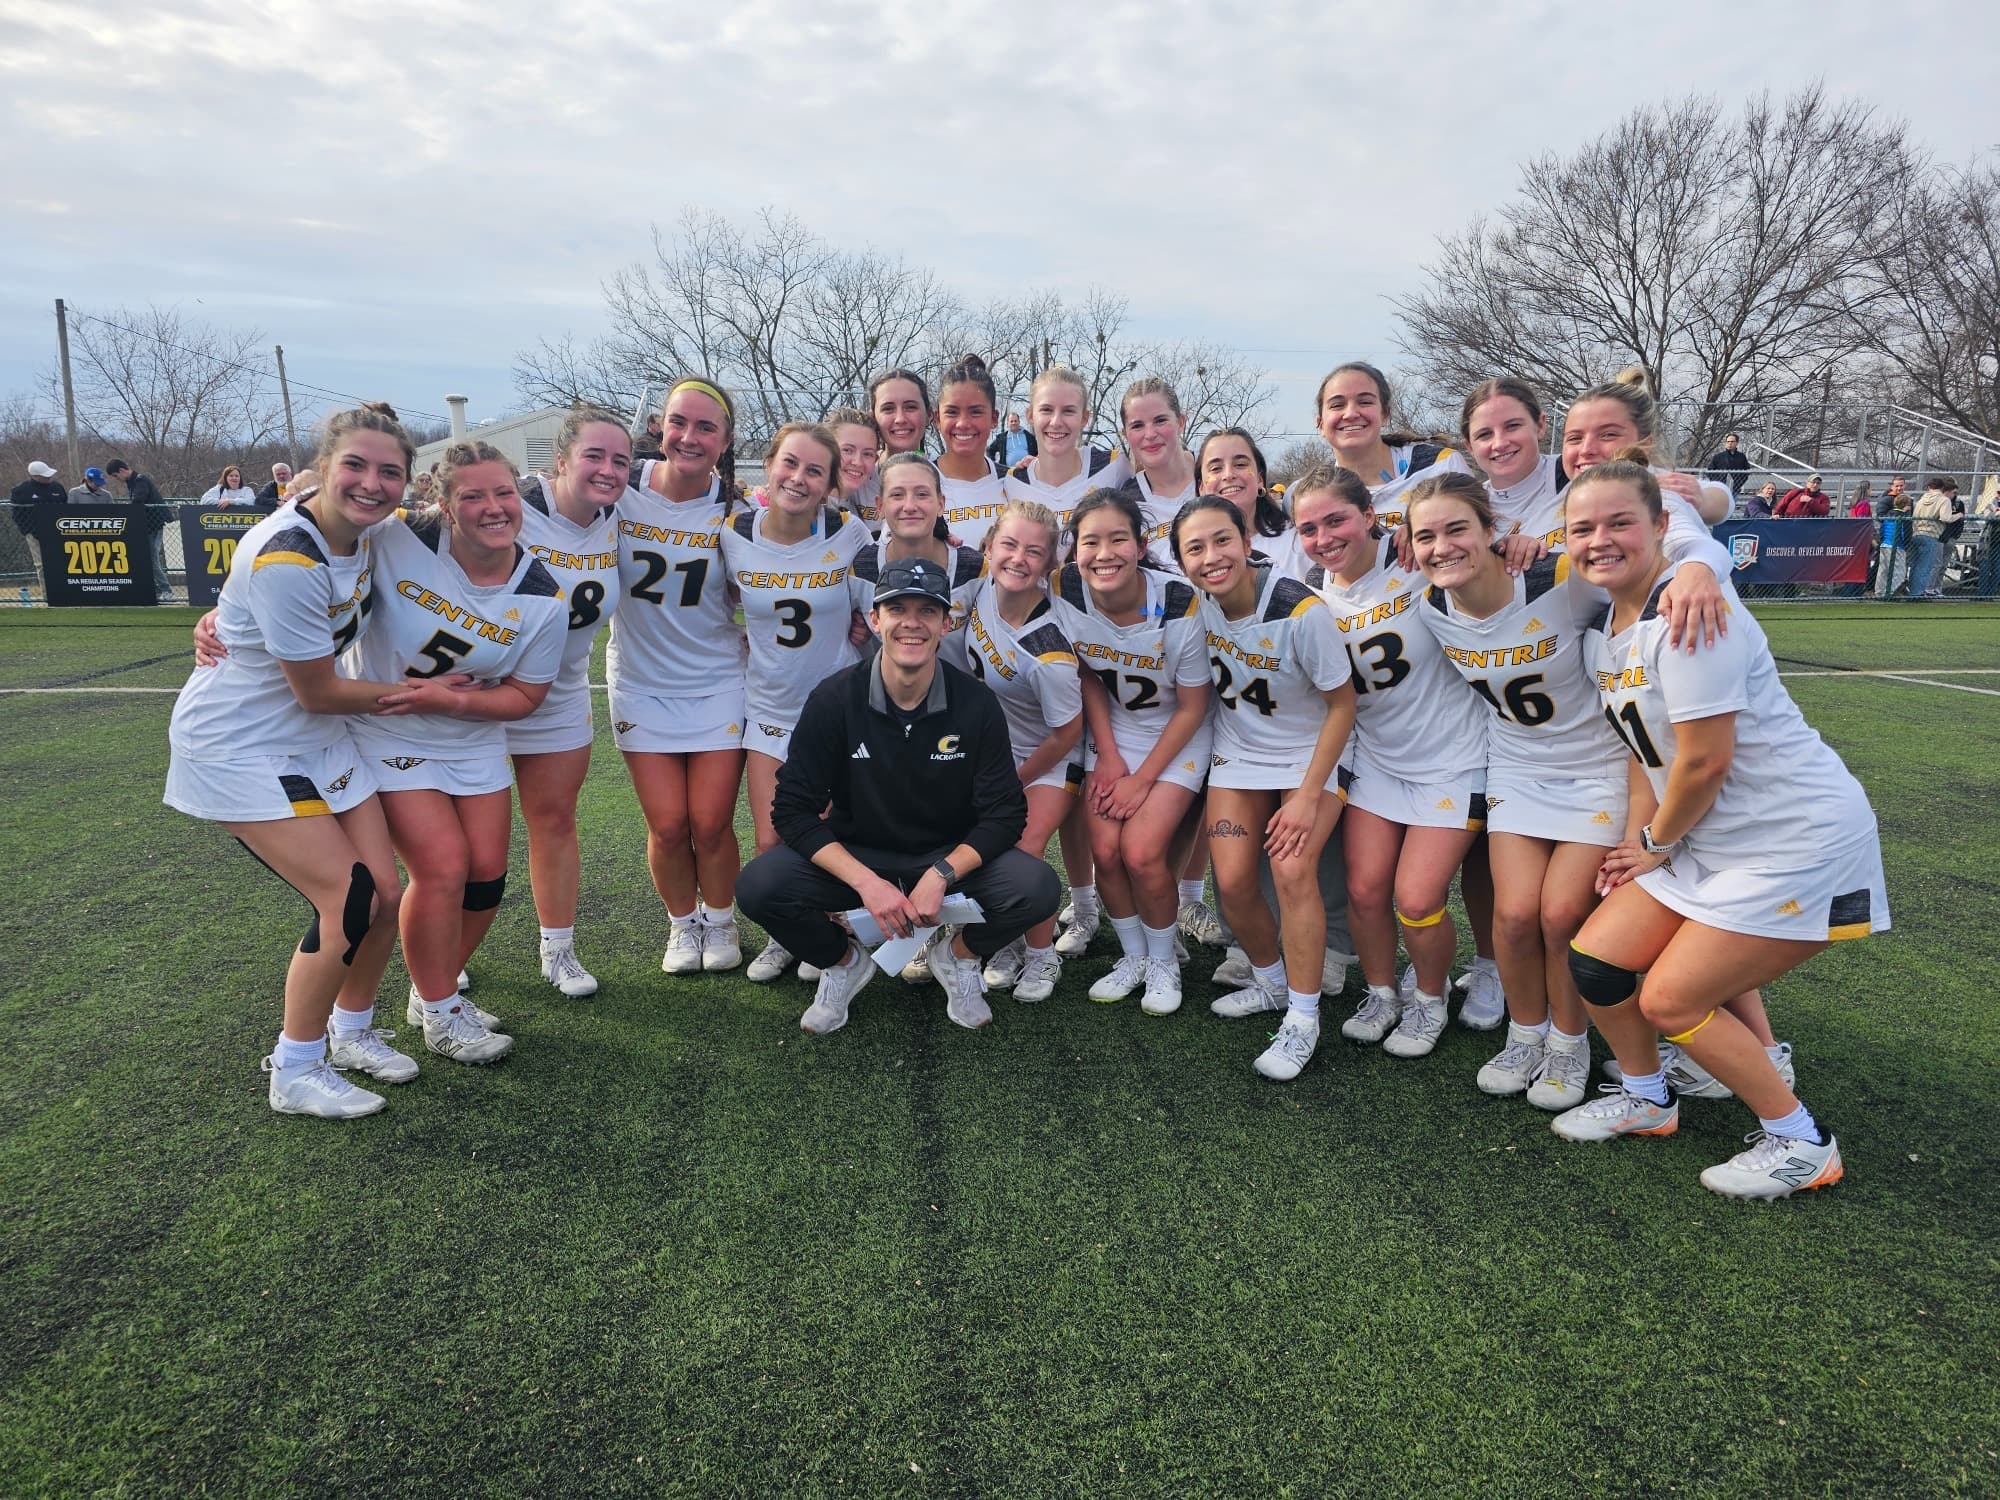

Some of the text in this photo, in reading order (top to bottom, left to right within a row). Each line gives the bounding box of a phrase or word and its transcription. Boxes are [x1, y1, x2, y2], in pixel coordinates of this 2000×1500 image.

[58, 519, 123, 529] CENTRE
[201, 515, 265, 524] CENTRE
[619, 520, 721, 549] CENTRE
[64, 541, 129, 574] 2023
[204, 538, 237, 575] 20
[1733, 542, 1752, 556] 50
[1766, 546, 1855, 557] DISCOVER. DEVELOP. DEDICATE.
[629, 550, 711, 608] 21
[737, 566, 848, 589] CENTRE
[396, 580, 519, 647] CENTRE
[567, 580, 605, 630] 8
[774, 597, 812, 649] 3
[1336, 591, 1412, 633] NTRE
[403, 627, 476, 680] 5
[1205, 629, 1281, 673] ENTRE
[1345, 631, 1412, 695] 13
[1444, 634, 1559, 669] CENTRE
[1095, 668, 1160, 711] 12
[1210, 655, 1277, 717] 24
[1468, 673, 1555, 727] 16
[937, 734, 961, 754] C
[1604, 700, 1664, 768] 11
[929, 752, 966, 761] LACROSSE
